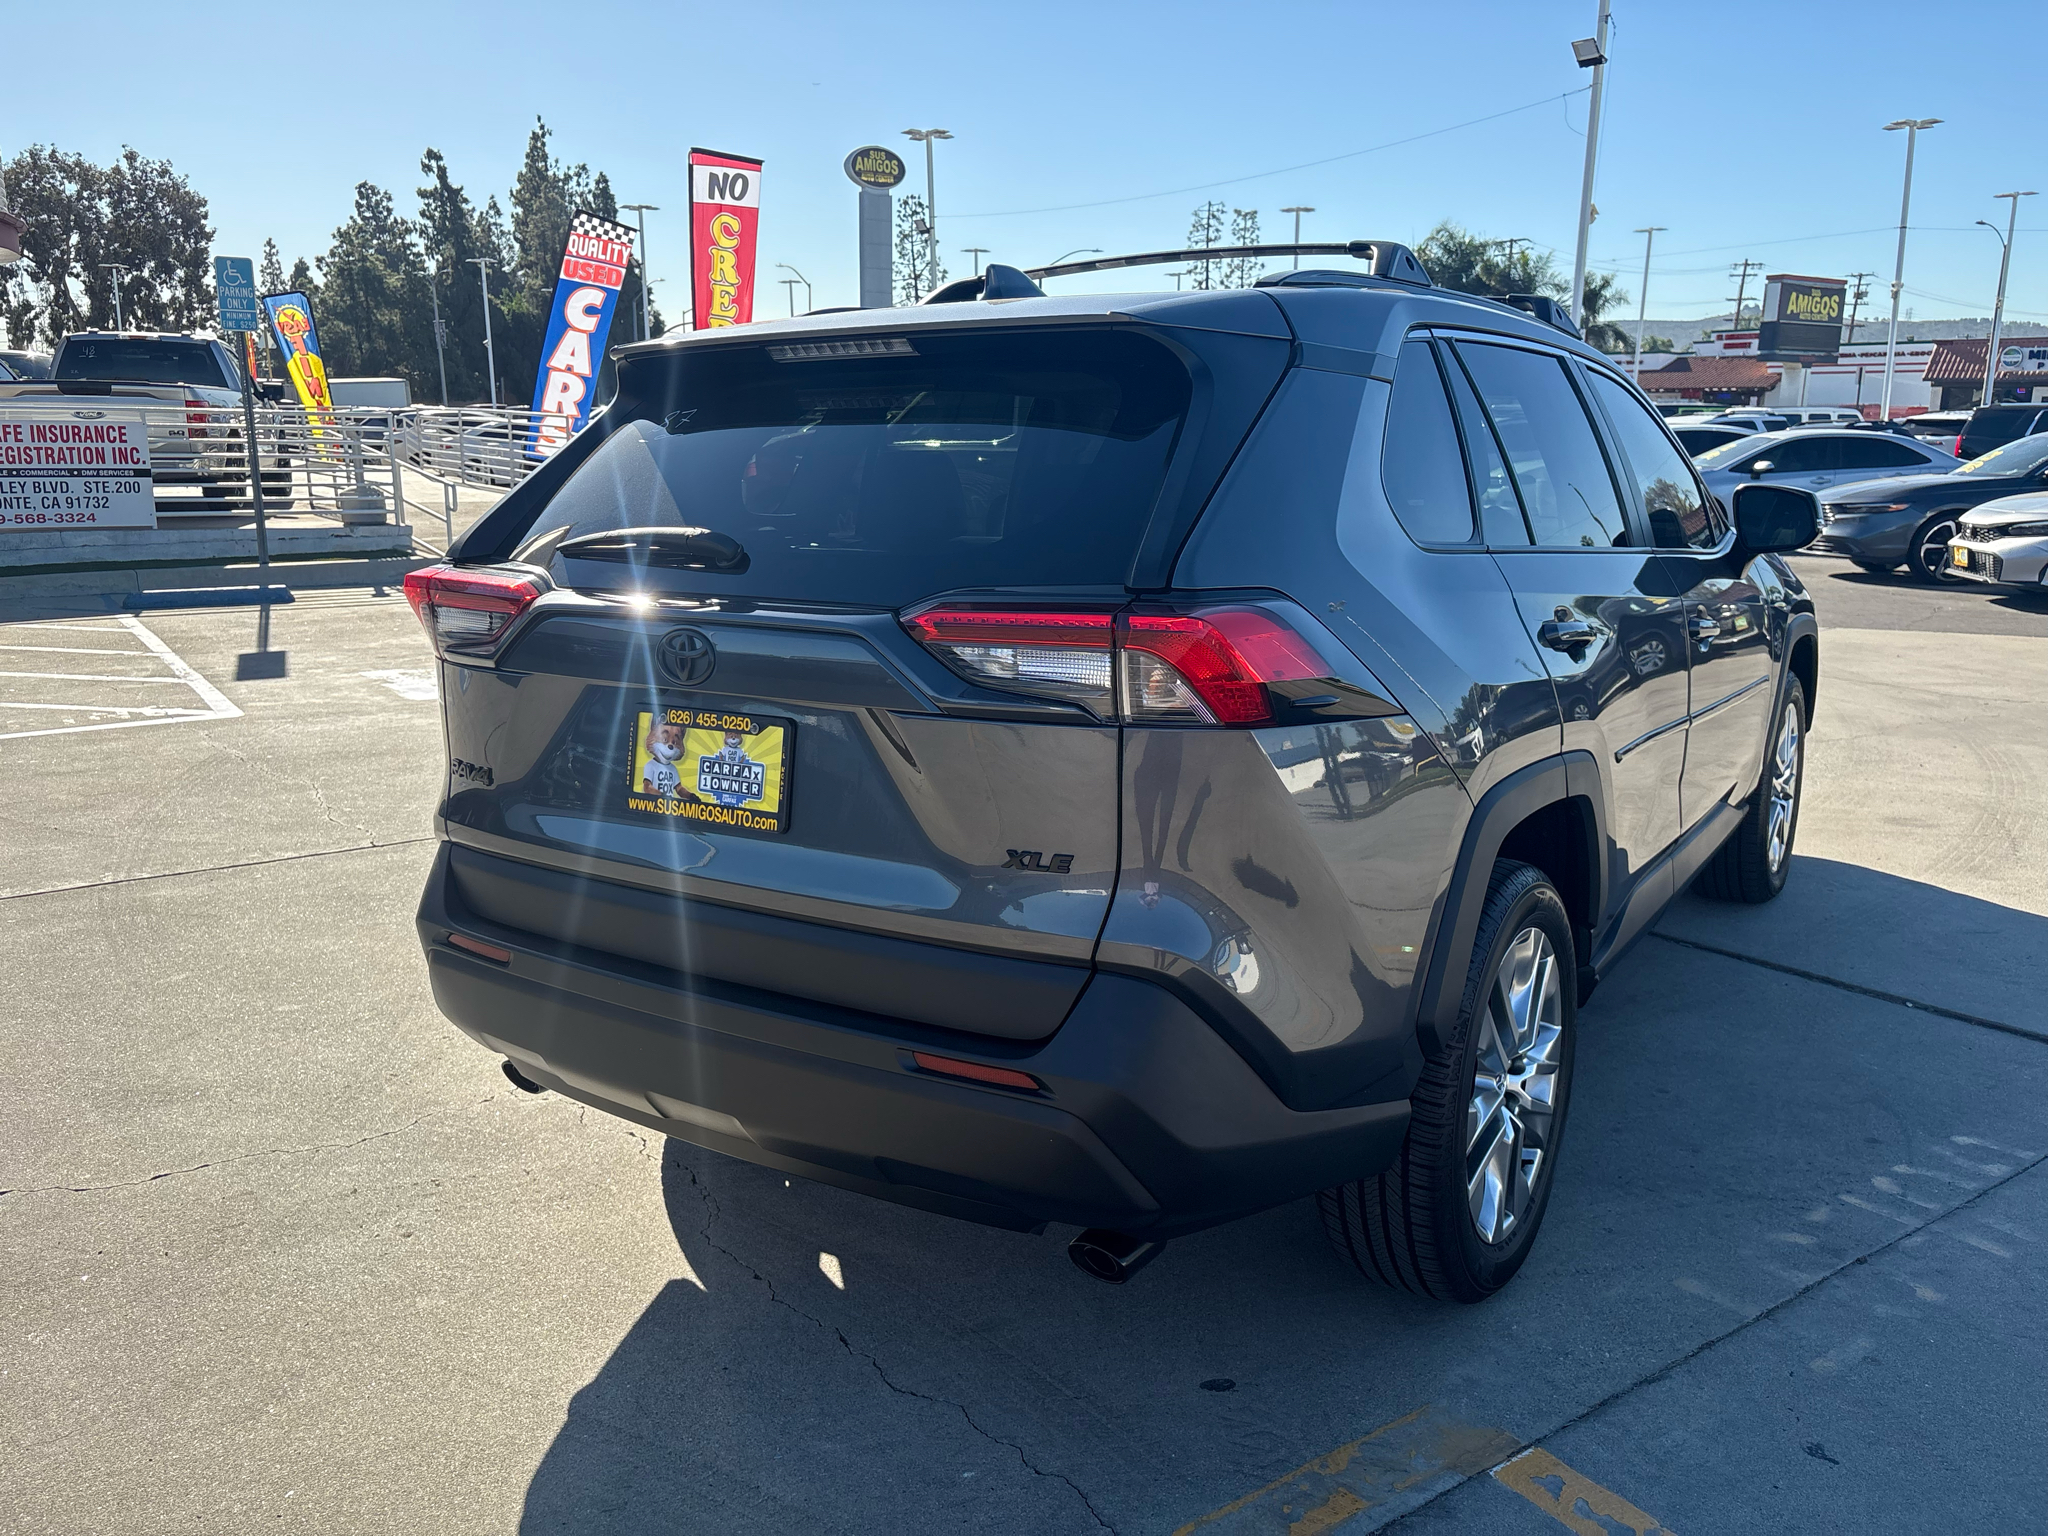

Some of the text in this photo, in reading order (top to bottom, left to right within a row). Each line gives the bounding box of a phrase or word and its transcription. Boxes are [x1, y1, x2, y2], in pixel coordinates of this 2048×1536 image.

[870, 151, 886, 160] SUS
[855, 156, 899, 175] AMIGOS
[708, 172, 749, 201] NO
[568, 235, 632, 266] QUALITY
[563, 258, 624, 287] USED
[219, 286, 254, 298] PARKING
[227, 298, 248, 309] ONLY
[1786, 292, 1840, 318] AMIGOS
[223, 320, 257, 329] FINE $250
[226, 312, 252, 320] MINIMUM
[0, 424, 128, 443] FE INSURANCE
[112, 447, 147, 465] INC.
[20, 469, 70, 477] COMMERCIAL
[81, 469, 97, 477] DMV
[99, 469, 135, 477] SERVICES
[33, 481, 74, 494] BLVD.
[0, 496, 110, 511] NTE, CA 91732
[667, 709, 751, 731] (626) 455-0250
[452, 757, 495, 787] RAV4
[657, 771, 674, 782] CAR
[703, 761, 760, 781] CARFAX
[657, 782, 674, 795] FOX
[702, 777, 759, 795] 1 OWNER
[628, 797, 778, 831] www.SUSAMIGOSAUTO.com
[1000, 848, 1075, 874] XLE
